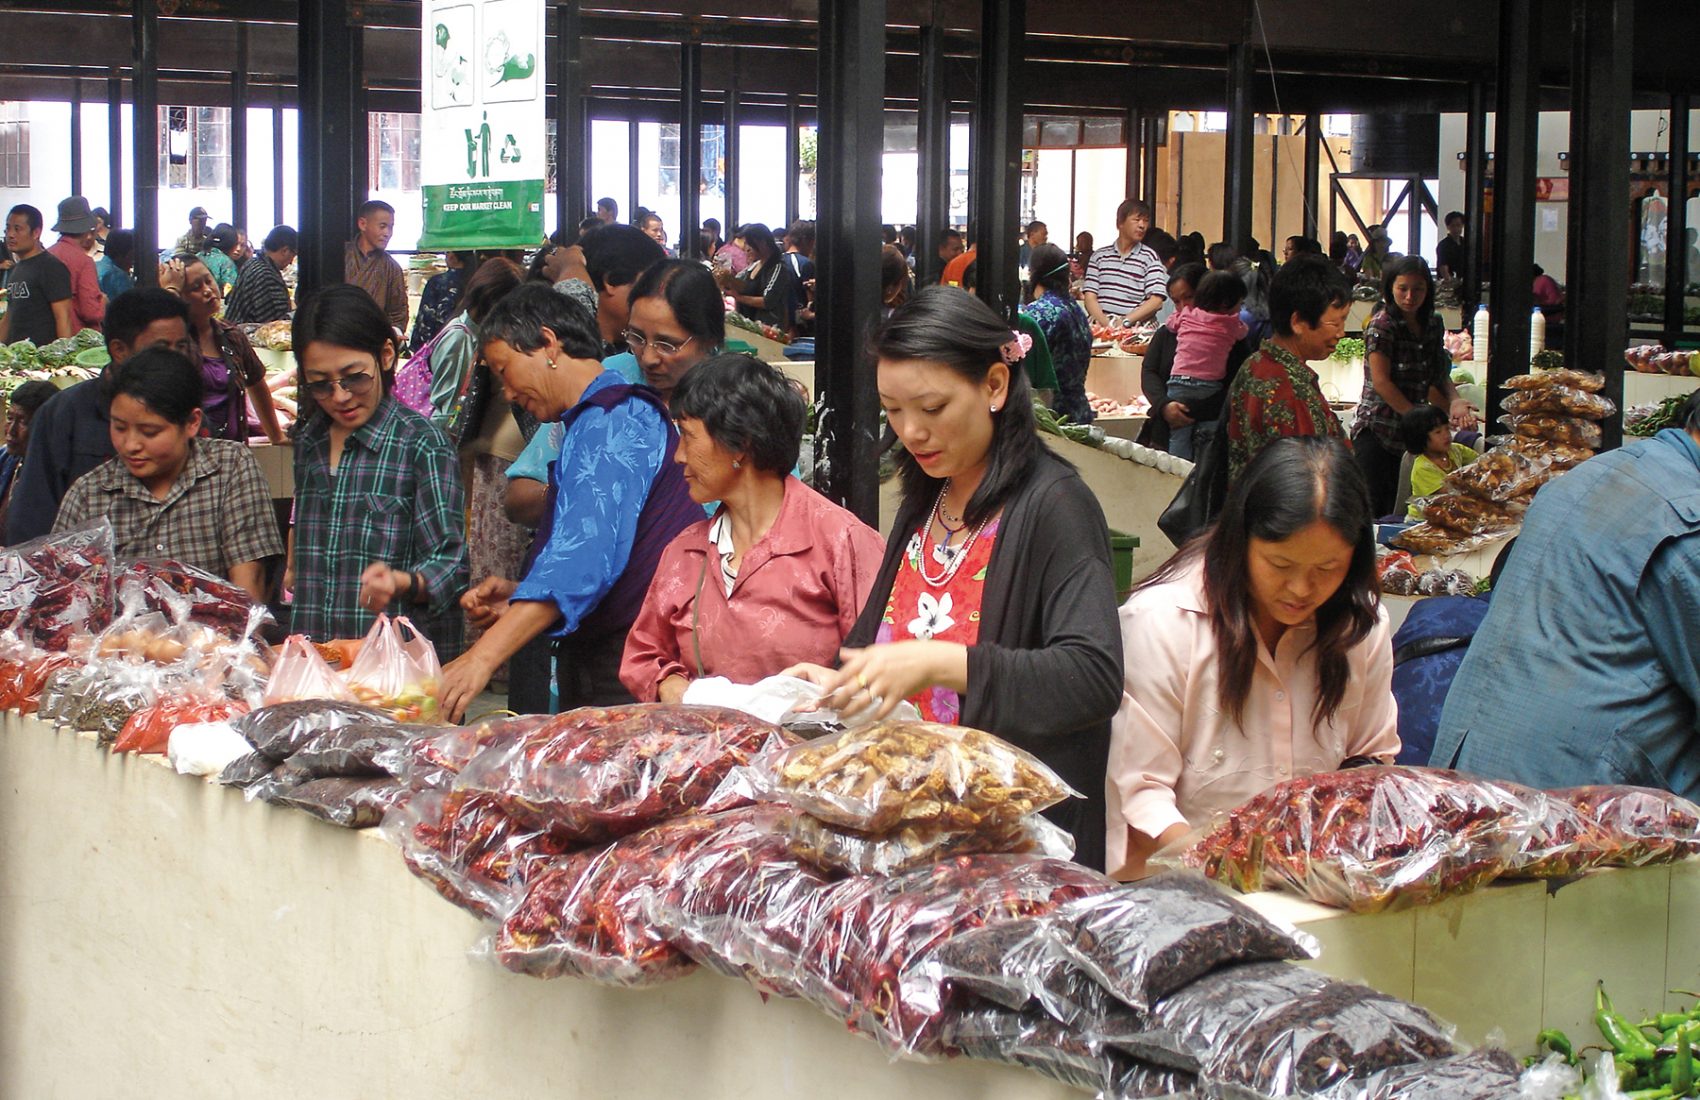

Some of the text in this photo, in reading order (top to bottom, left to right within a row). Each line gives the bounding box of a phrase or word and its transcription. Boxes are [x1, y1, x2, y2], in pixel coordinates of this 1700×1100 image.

[460, 203, 472, 211] OUR
[472, 202, 493, 211] MARKET
[494, 201, 512, 210] CLEAN
